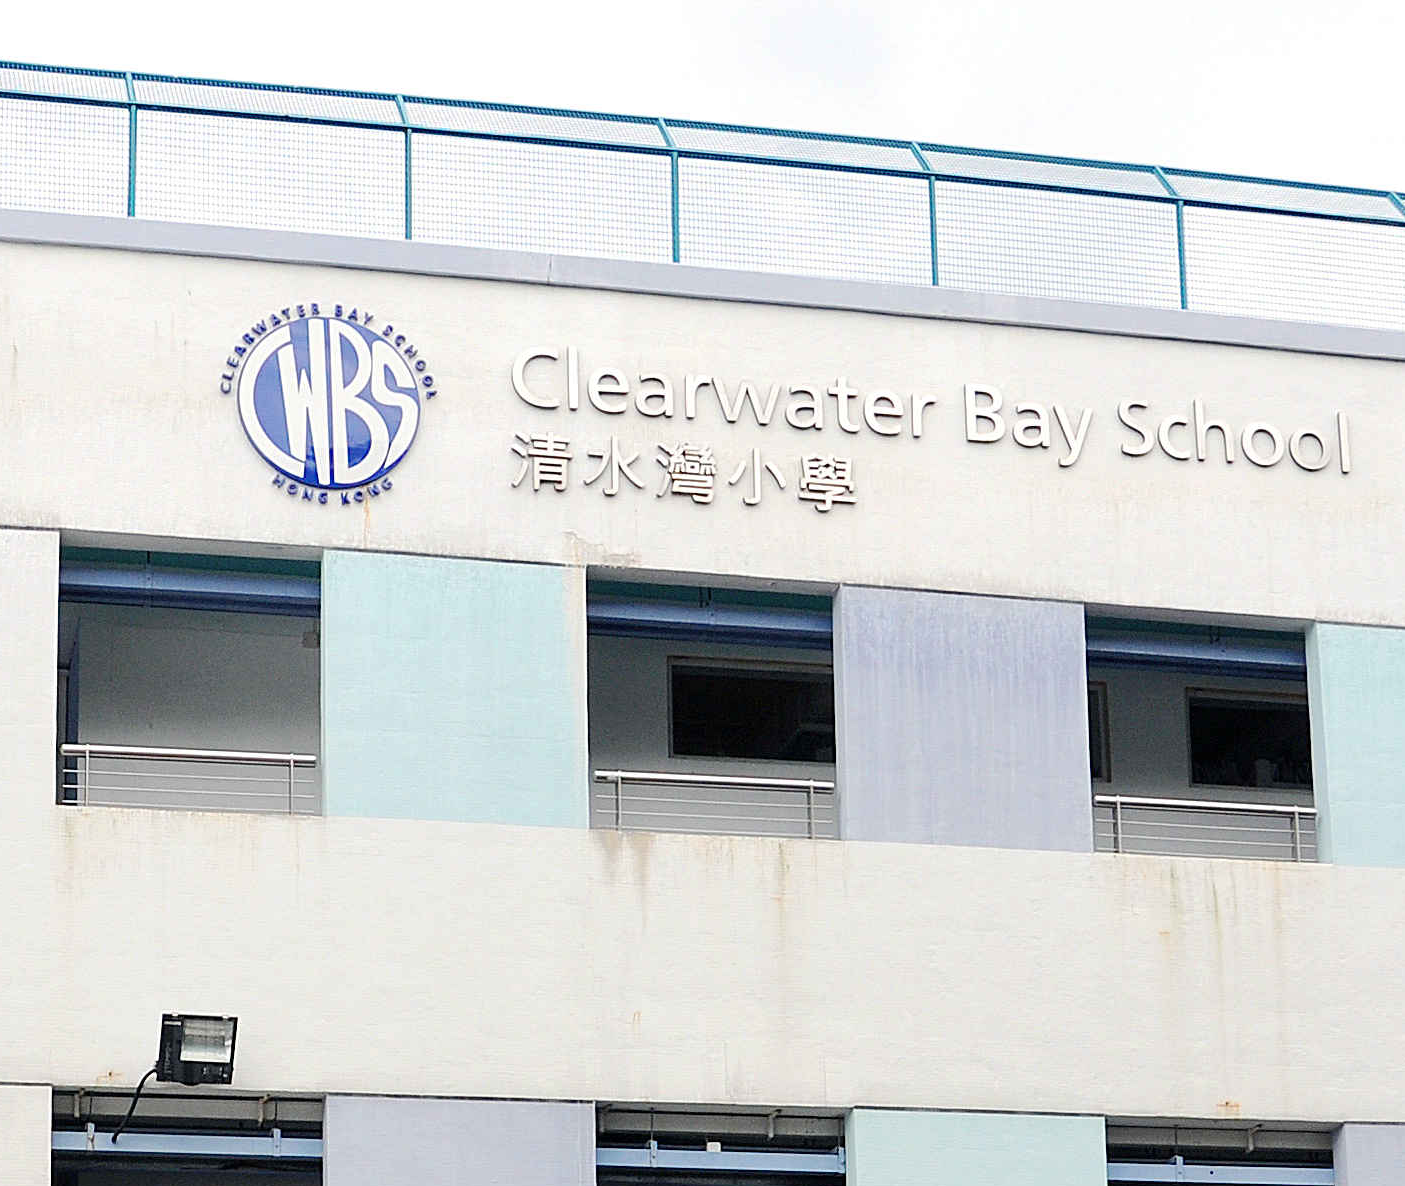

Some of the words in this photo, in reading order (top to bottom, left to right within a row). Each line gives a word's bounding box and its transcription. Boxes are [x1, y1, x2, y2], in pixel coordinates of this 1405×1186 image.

[220, 303, 321, 395] CLEARWATER
[334, 304, 374, 326] BAY
[382, 325, 438, 400] SCHOOL
[511, 345, 936, 439] Clearwater
[963, 383, 1094, 468] Bay
[1117, 394, 1353, 474] School
[273, 474, 329, 506] HONG
[341, 477, 394, 506] KONG
[511, 431, 860, 513] 清水灣小學
